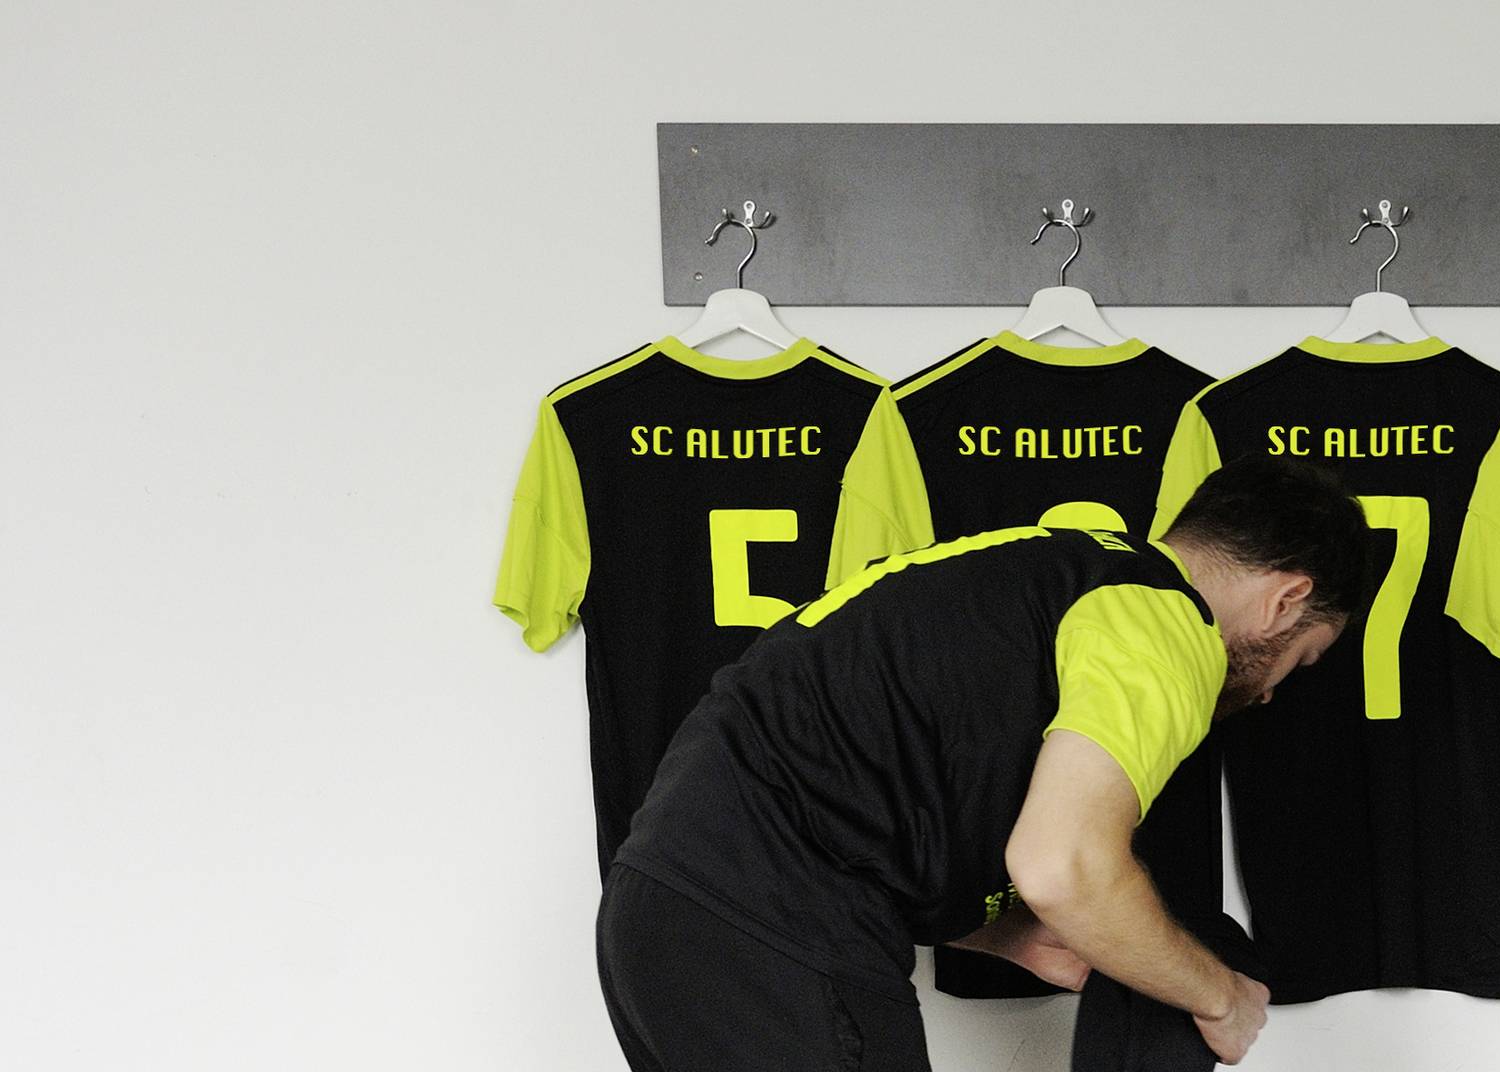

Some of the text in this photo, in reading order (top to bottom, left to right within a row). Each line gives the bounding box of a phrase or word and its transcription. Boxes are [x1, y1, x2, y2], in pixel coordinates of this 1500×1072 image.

[631, 425, 820, 459] SC ALUTEC
[958, 425, 1143, 459] SC ALUTEC
[1267, 424, 1454, 458] SC ALUTEC
[1356, 495, 1430, 721] 7
